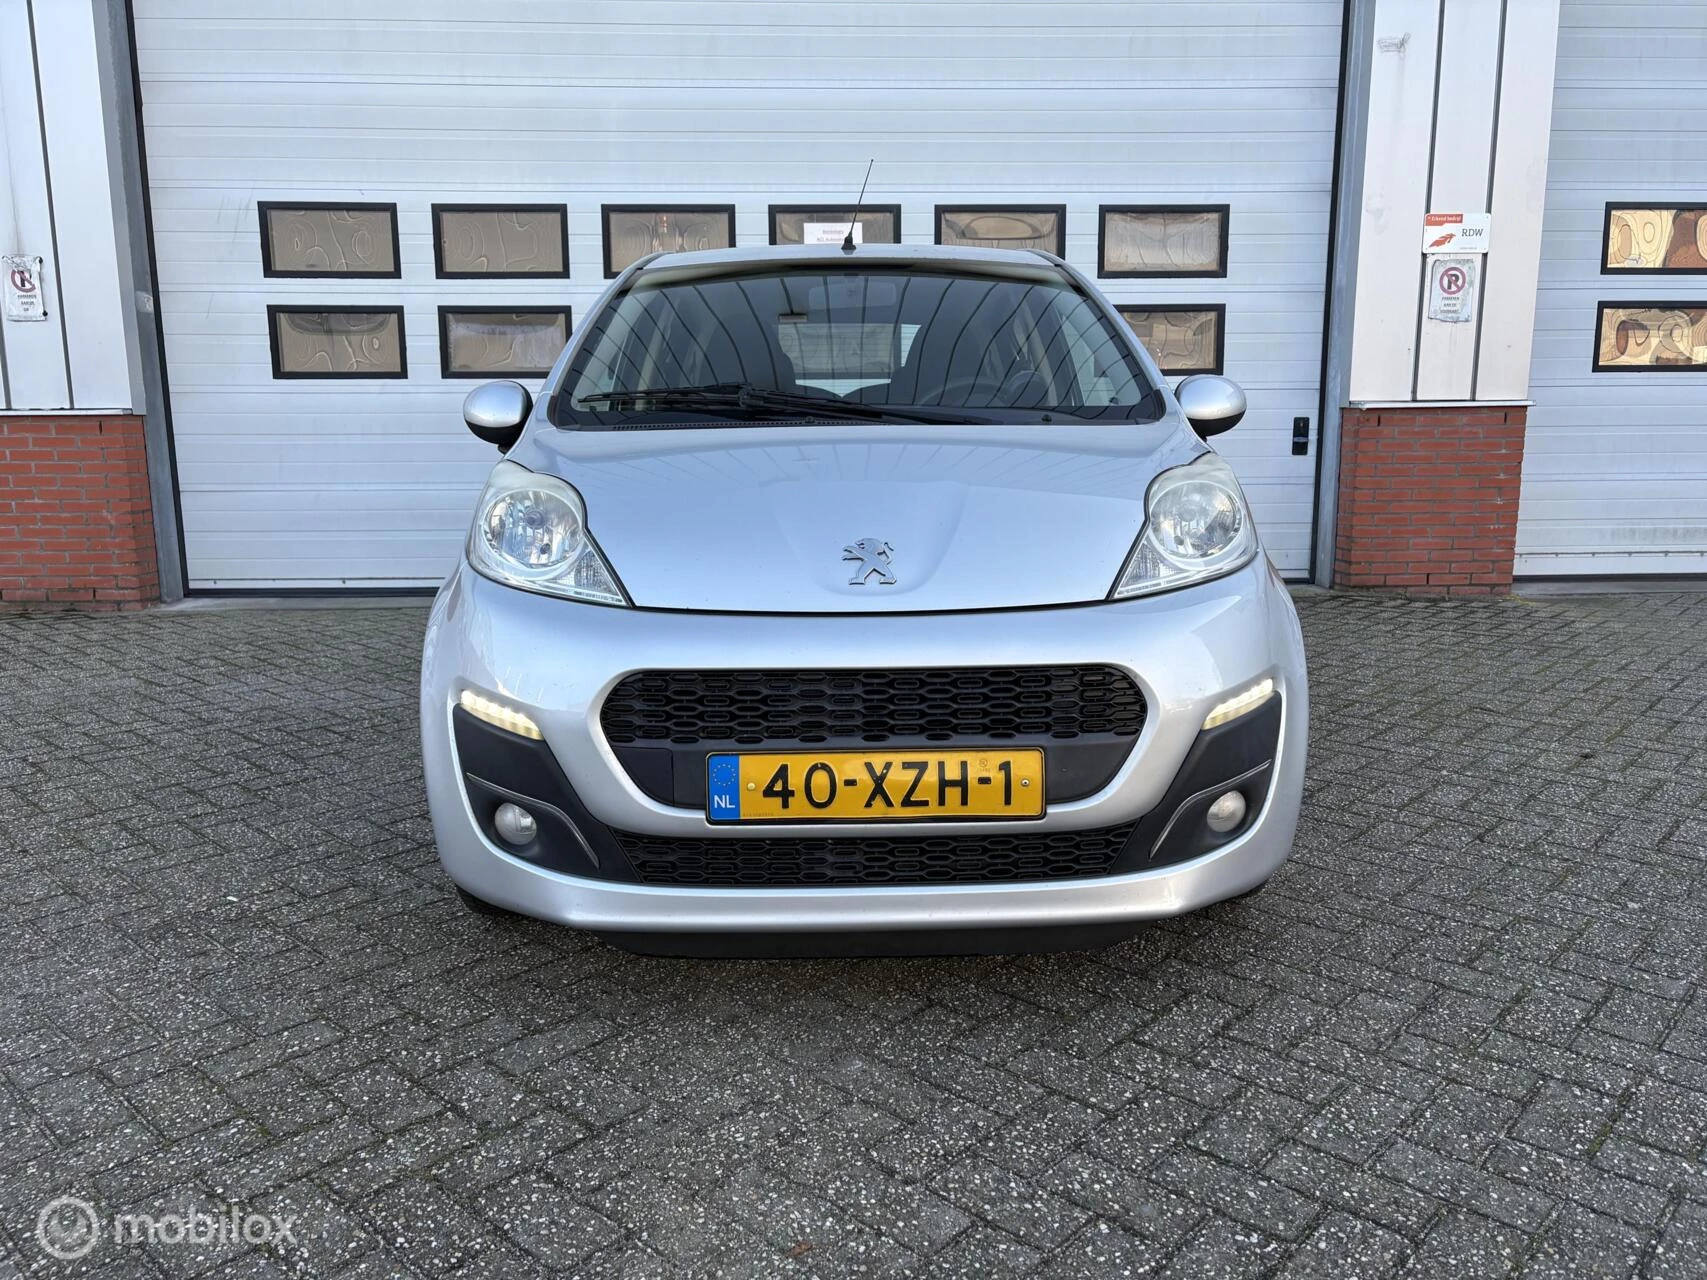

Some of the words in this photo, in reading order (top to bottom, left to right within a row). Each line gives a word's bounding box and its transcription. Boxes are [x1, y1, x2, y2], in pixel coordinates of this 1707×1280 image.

[1461, 228, 1483, 237] RDW
[761, 759, 1013, 810] 40-XZH-1
[713, 794, 736, 809] NL
